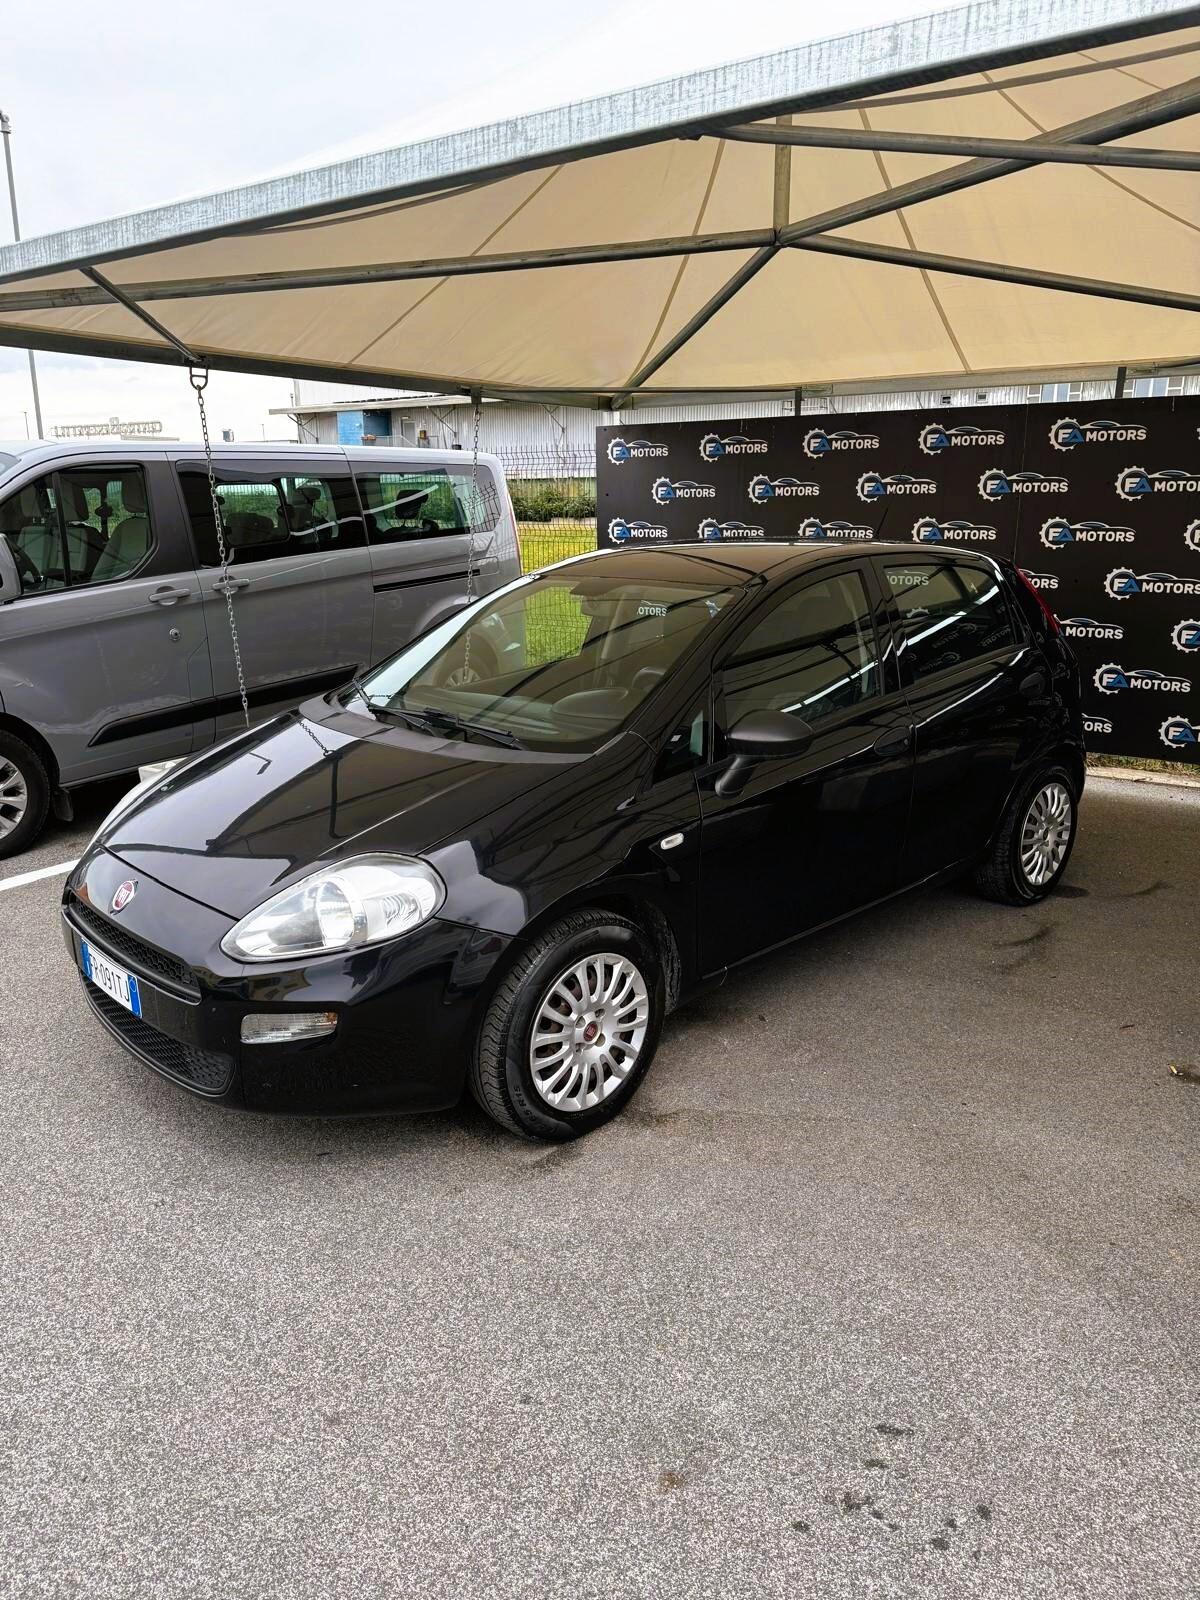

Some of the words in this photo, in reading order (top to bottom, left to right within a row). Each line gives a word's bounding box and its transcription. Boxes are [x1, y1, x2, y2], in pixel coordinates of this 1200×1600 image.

[926, 433, 950, 447] FA
[951, 434, 1005, 446] MOTORS
[1058, 428, 1084, 443] FA
[1086, 429, 1147, 442] MOTORS
[705, 442, 725, 455] FA
[725, 443, 768, 454] MOTORS
[810, 438, 831, 451] FA
[832, 439, 880, 450] MOTORS
[613, 446, 631, 458] FA
[631, 447, 669, 458] MOTORS
[755, 485, 774, 497] FA
[775, 486, 820, 496] MOTORS
[863, 482, 886, 495] FA
[887, 483, 937, 494] MOTORS
[986, 480, 1011, 493] FA
[1012, 482, 1069, 493] MOTORS
[1124, 477, 1152, 492] FA
[1154, 480, 1200, 492] MOTO
[658, 486, 676, 498] FA
[676, 488, 716, 498] MOTORS
[613, 526, 631, 538] FA
[631, 528, 668, 538] MOTORS
[827, 529, 873, 539] MOTORS
[920, 527, 943, 540] FA
[944, 529, 997, 540] MOTORS
[1048, 527, 1074, 541] FA
[1076, 530, 1136, 542] MOTORS
[1113, 578, 1141, 592] FA
[637, 606, 667, 617] OTORS
[1065, 626, 1124, 640] MOTORS
[1102, 673, 1130, 688] FA
[1130, 678, 1191, 693] MOTORS
[1168, 726, 1196, 742] FA
